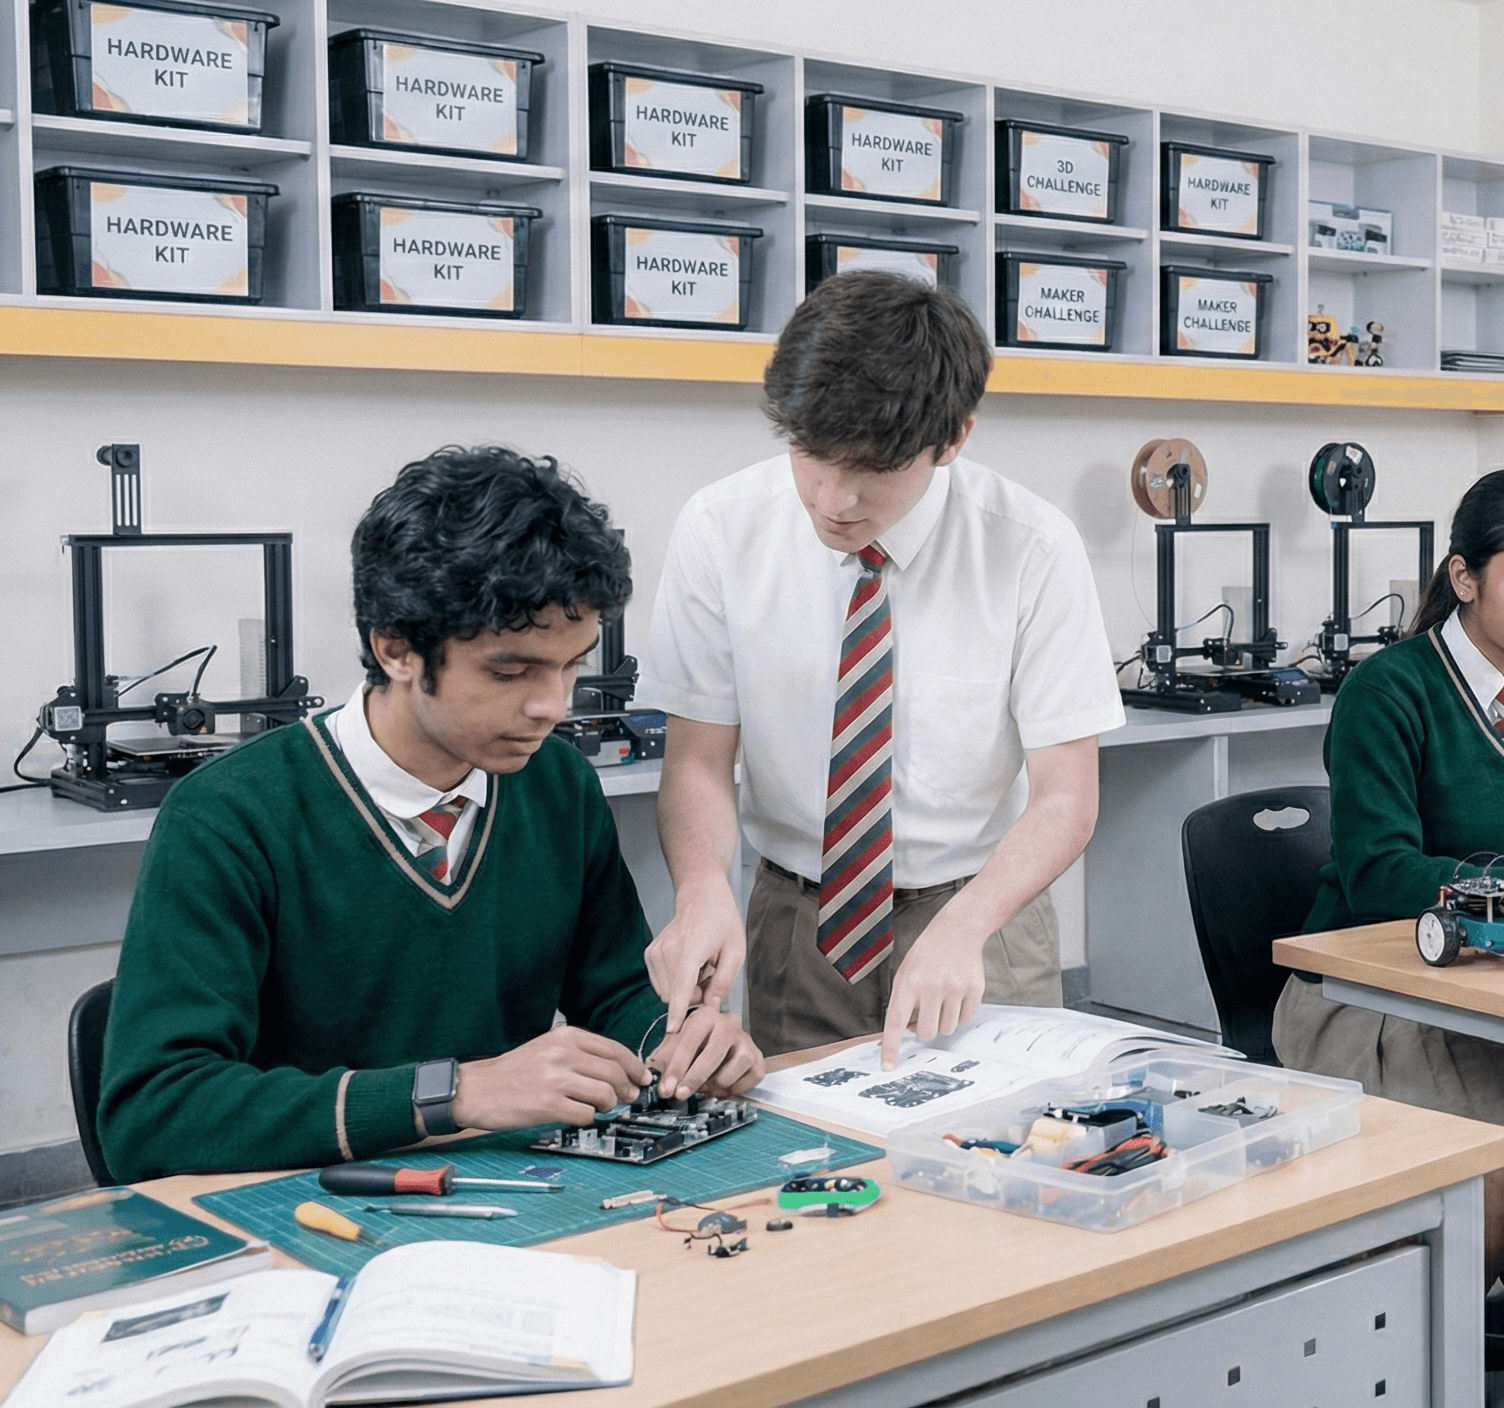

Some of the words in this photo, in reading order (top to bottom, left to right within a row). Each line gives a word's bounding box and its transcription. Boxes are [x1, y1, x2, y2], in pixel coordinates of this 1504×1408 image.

[108, 38, 232, 69] HARDWARE
[155, 69, 188, 88] KIT
[397, 76, 503, 103] HARDWARE
[436, 103, 465, 121] KIT
[637, 106, 728, 131] HARDWARE
[672, 131, 696, 147] KIT
[852, 133, 932, 156] HARDWARE
[882, 158, 903, 172] KIT
[1058, 160, 1073, 173] 3D
[1027, 176, 1100, 196] CHALLENGE
[1189, 178, 1250, 195] HARDWARE
[1211, 199, 1228, 210] KIT
[107, 217, 232, 241] HARDWARE
[156, 246, 189, 263] KIT
[394, 238, 500, 260] HARDWARE
[434, 264, 463, 280] KIT
[637, 256, 728, 276] HARDWARE
[672, 281, 696, 295] KIT
[1041, 288, 1084, 302] MAKER
[1025, 306, 1099, 323] CHALLENGE
[1199, 299, 1236, 313] MAKER
